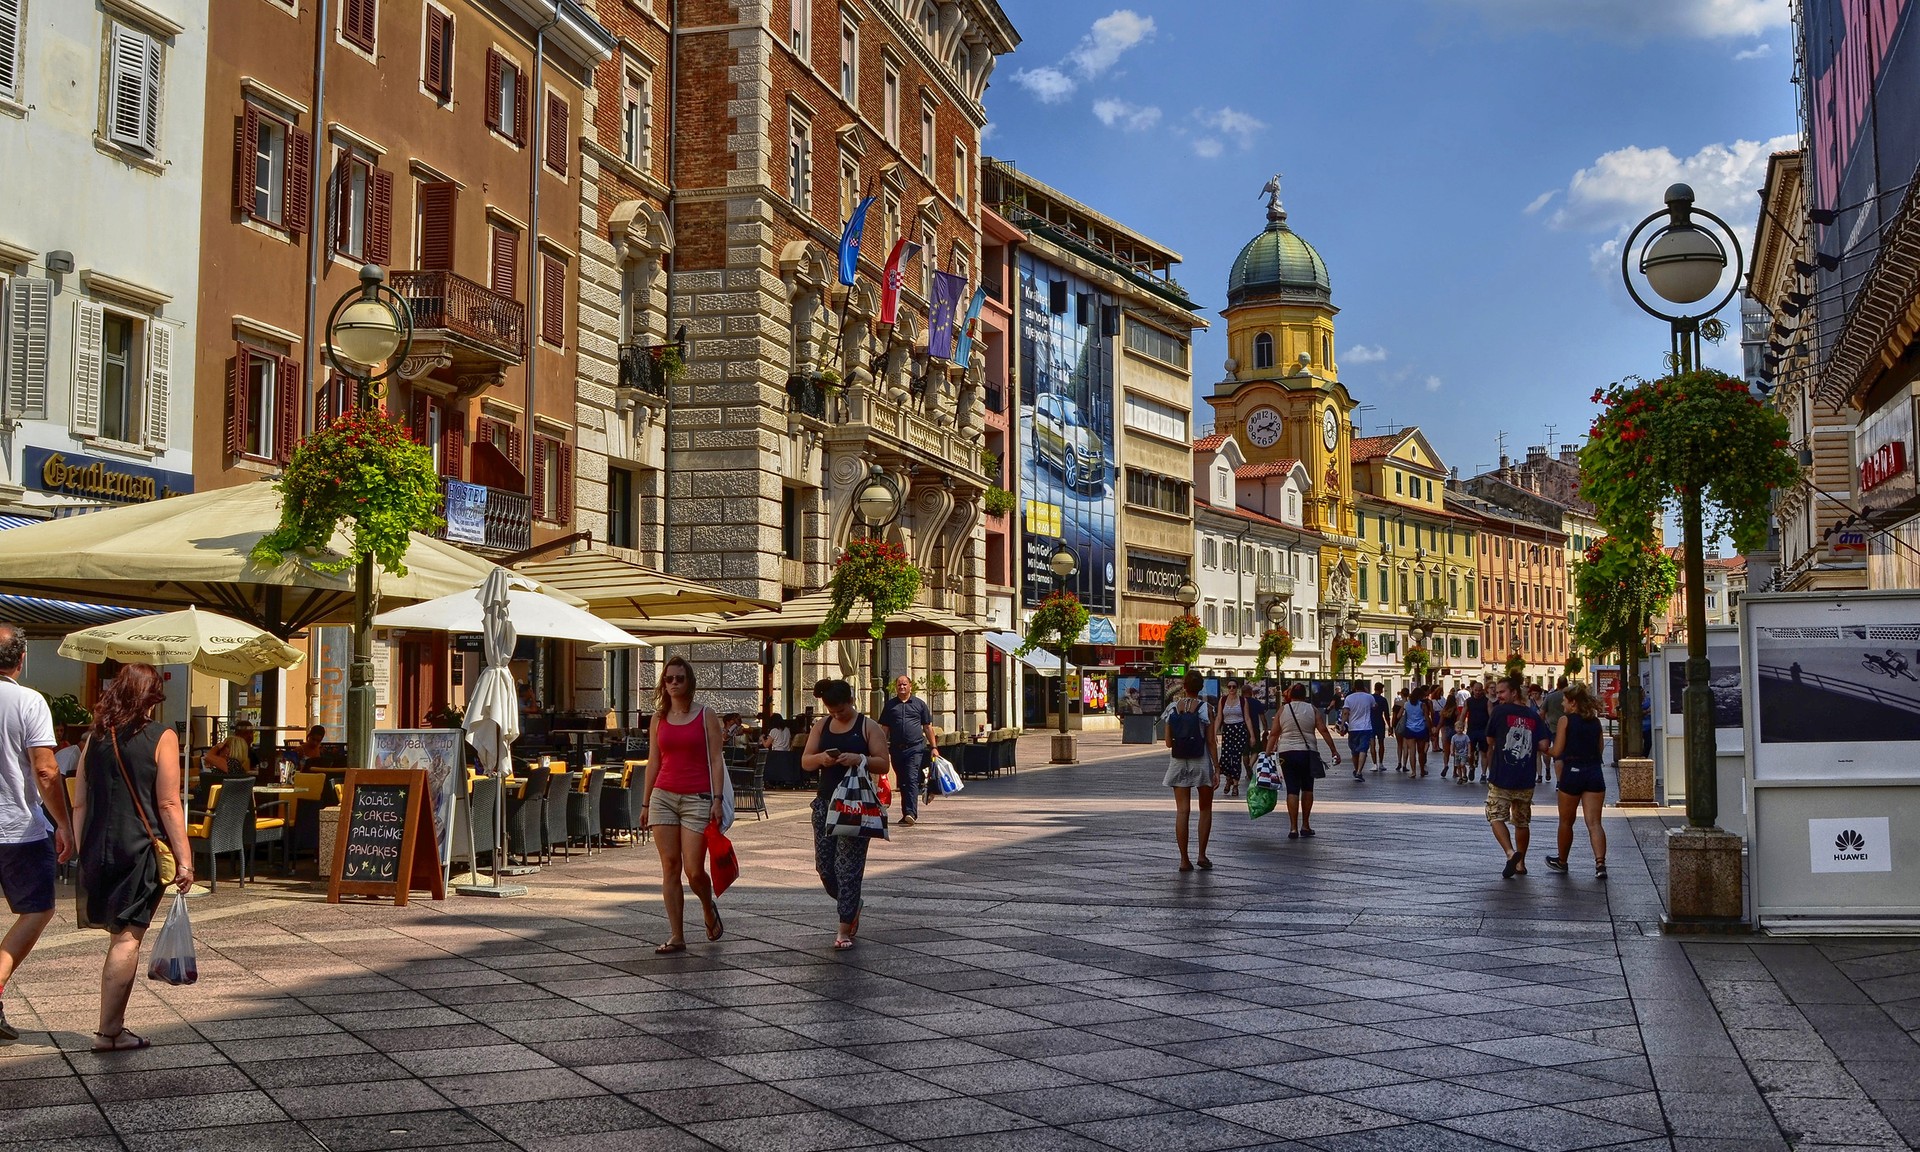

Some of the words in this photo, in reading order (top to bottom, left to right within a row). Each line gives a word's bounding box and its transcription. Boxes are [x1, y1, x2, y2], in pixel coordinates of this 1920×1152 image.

[43, 452, 156, 500] Gentleman
[448, 483, 487, 504] HOSTEL
[1839, 531, 1863, 544] dm
[1027, 542, 1040, 556] Noi
[363, 809, 398, 822] CAKES
[352, 825, 404, 840] PALAČINKE
[348, 844, 398, 859] PANCAKES
[1833, 853, 1868, 861] HUAWEI
